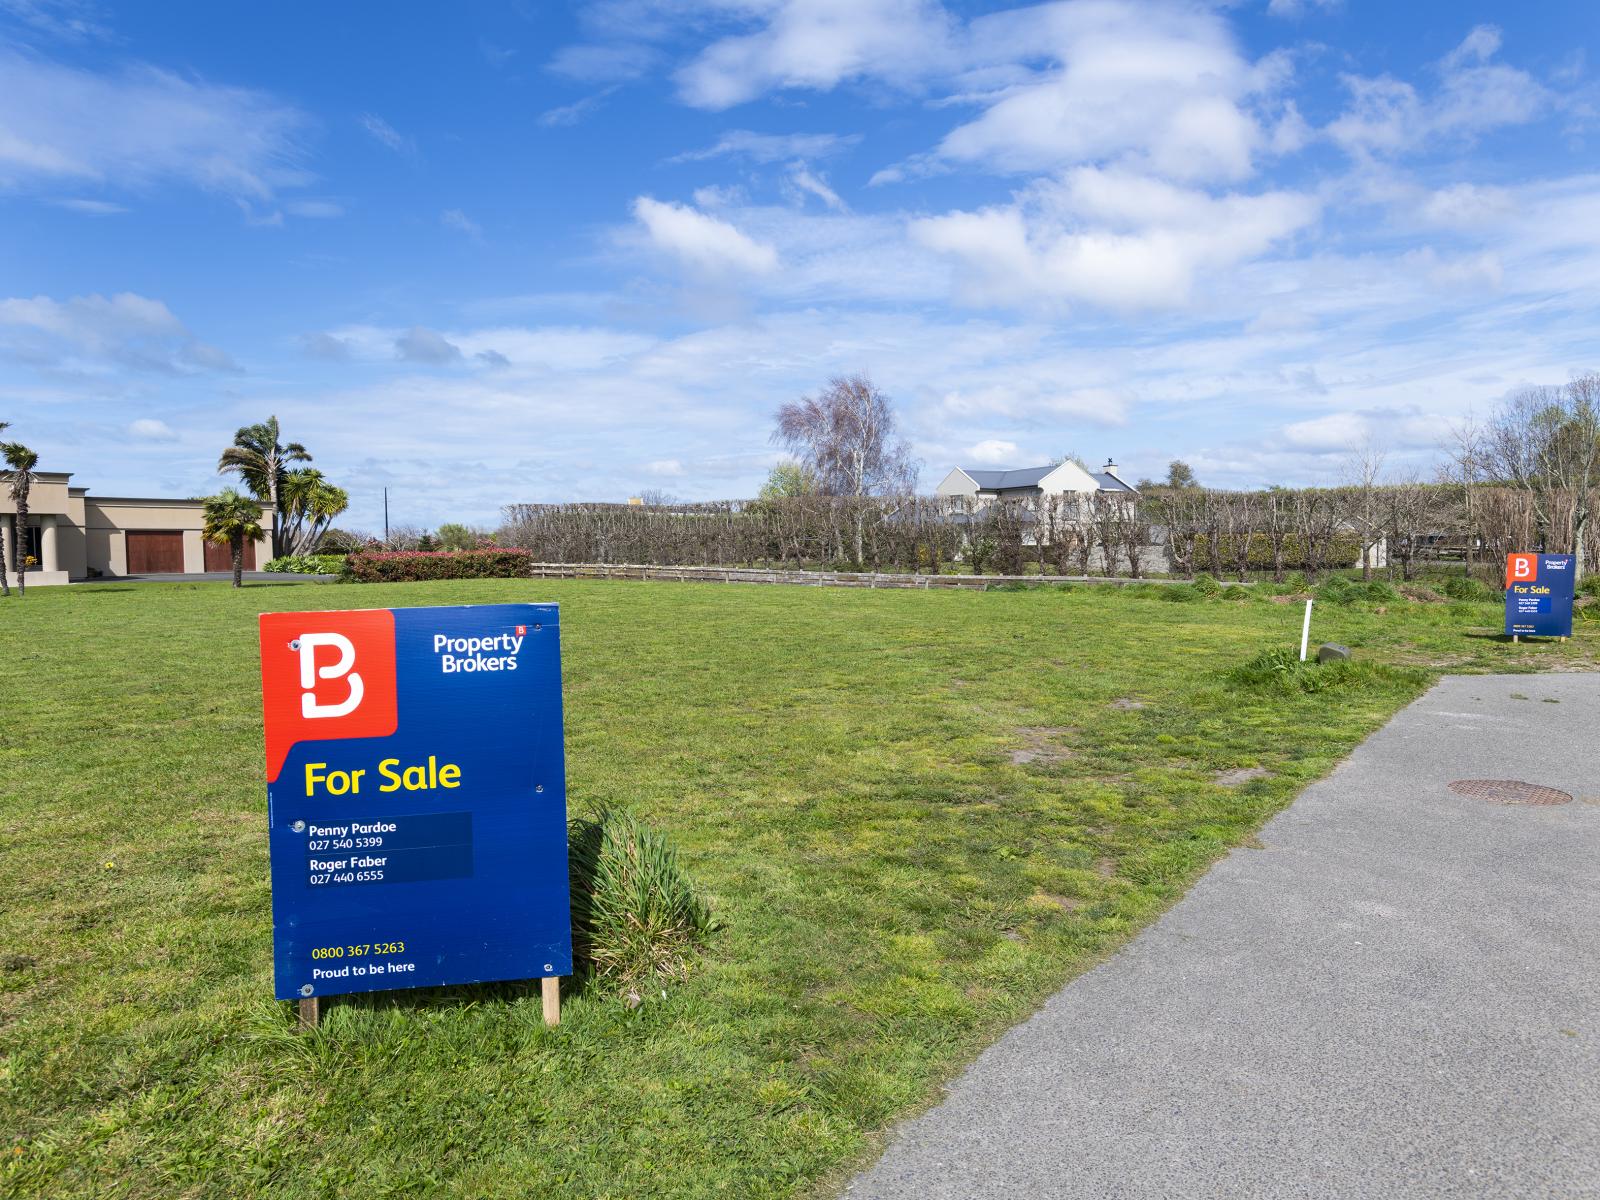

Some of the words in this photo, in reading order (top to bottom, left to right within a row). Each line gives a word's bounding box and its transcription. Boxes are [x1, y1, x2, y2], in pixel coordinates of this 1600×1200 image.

[1514, 558, 1530, 577] B
[1514, 586, 1528, 594] For
[1530, 586, 1550, 594] Sale
[433, 633, 524, 655] Property
[441, 653, 518, 673] Brokers
[299, 632, 364, 719] B
[305, 762, 366, 797] For
[378, 755, 462, 793] Sale
[309, 825, 349, 838] Penny
[351, 821, 397, 835] Pardoe
[309, 839, 330, 851] 027
[332, 838, 353, 850] 540
[355, 836, 383, 849] 5399
[310, 859, 348, 872] Roger
[350, 855, 388, 869] Faber
[310, 873, 331, 885] 027
[333, 872, 354, 884] 440
[356, 870, 384, 882] 6555
[311, 946, 344, 961] 0800
[347, 944, 370, 958] 367
[373, 941, 405, 956] 5263
[312, 965, 350, 981] Proud
[352, 966, 366, 977] to
[369, 963, 385, 975] be
[387, 962, 416, 973] here
